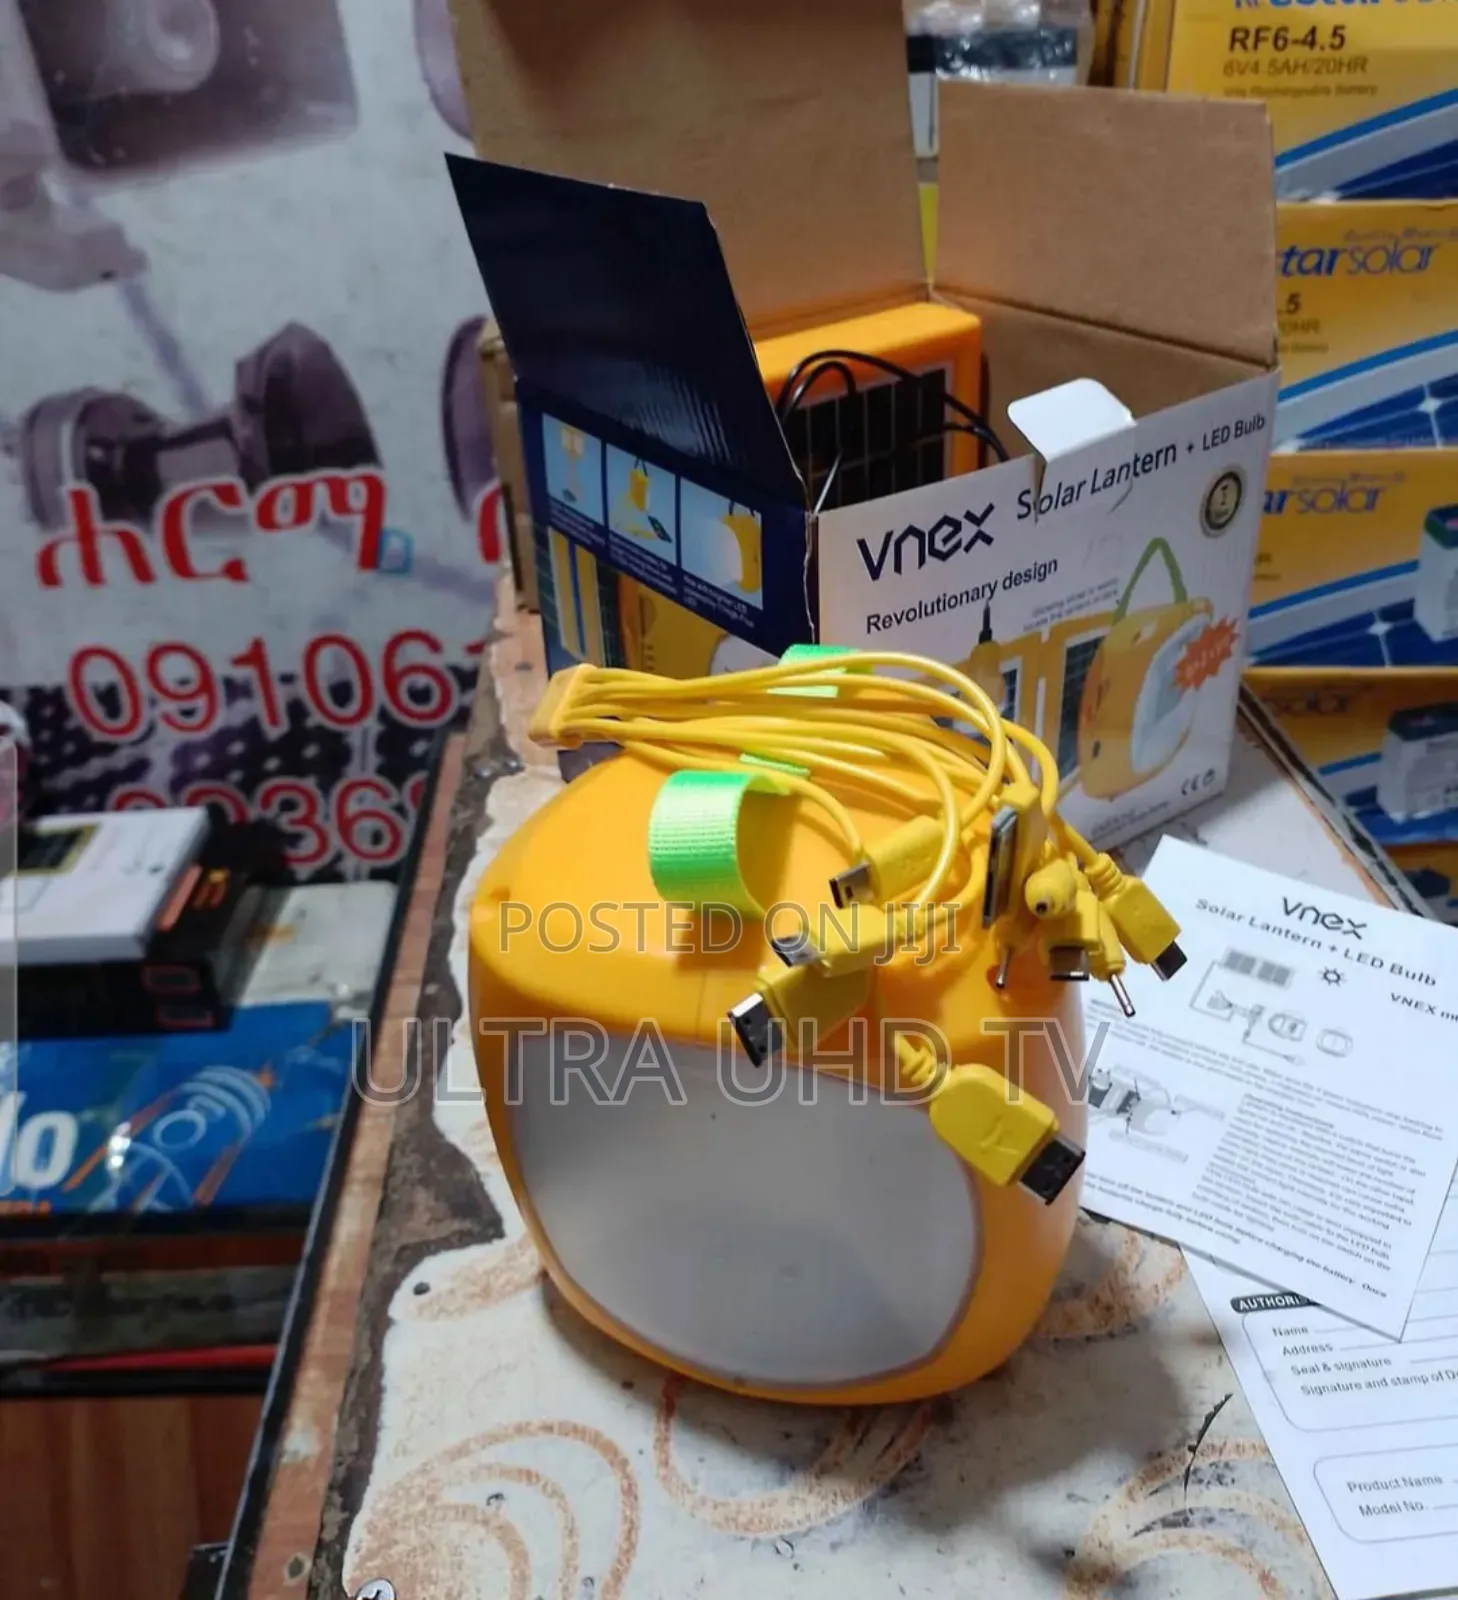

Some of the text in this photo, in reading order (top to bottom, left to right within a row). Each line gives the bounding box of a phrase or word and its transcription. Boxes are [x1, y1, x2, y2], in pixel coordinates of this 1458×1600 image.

[1228, 24, 1347, 53] RF6-4.5
[1016, 477, 1087, 522] Solar
[1090, 441, 1178, 496] Lantern
[1202, 426, 1231, 451] LED
[1234, 413, 1266, 438] Bulb
[866, 580, 999, 634] Revolutionary
[1002, 558, 1058, 592] design
[67, 630, 487, 739] 09106
[1195, 898, 1245, 923] Solar
[1248, 916, 1323, 950] Lantern
[1344, 948, 1384, 969] LED
[1389, 962, 1437, 987] Bulb
[1390, 992, 1437, 1016] VNEX
[1239, 1294, 1307, 1311] AUTHORI
[1272, 1326, 1309, 1338] Name
[1283, 1342, 1334, 1357] Address
[1290, 1362, 1321, 1376] Seal
[1333, 1357, 1393, 1373] signature
[1300, 1381, 1363, 1397] Signature
[1364, 1376, 1389, 1389] and
[1390, 1374, 1429, 1386] stamp
[1431, 1369, 1444, 1383] of
[1346, 1476, 1443, 1493] Product Name
[1358, 1502, 1403, 1517] Model
